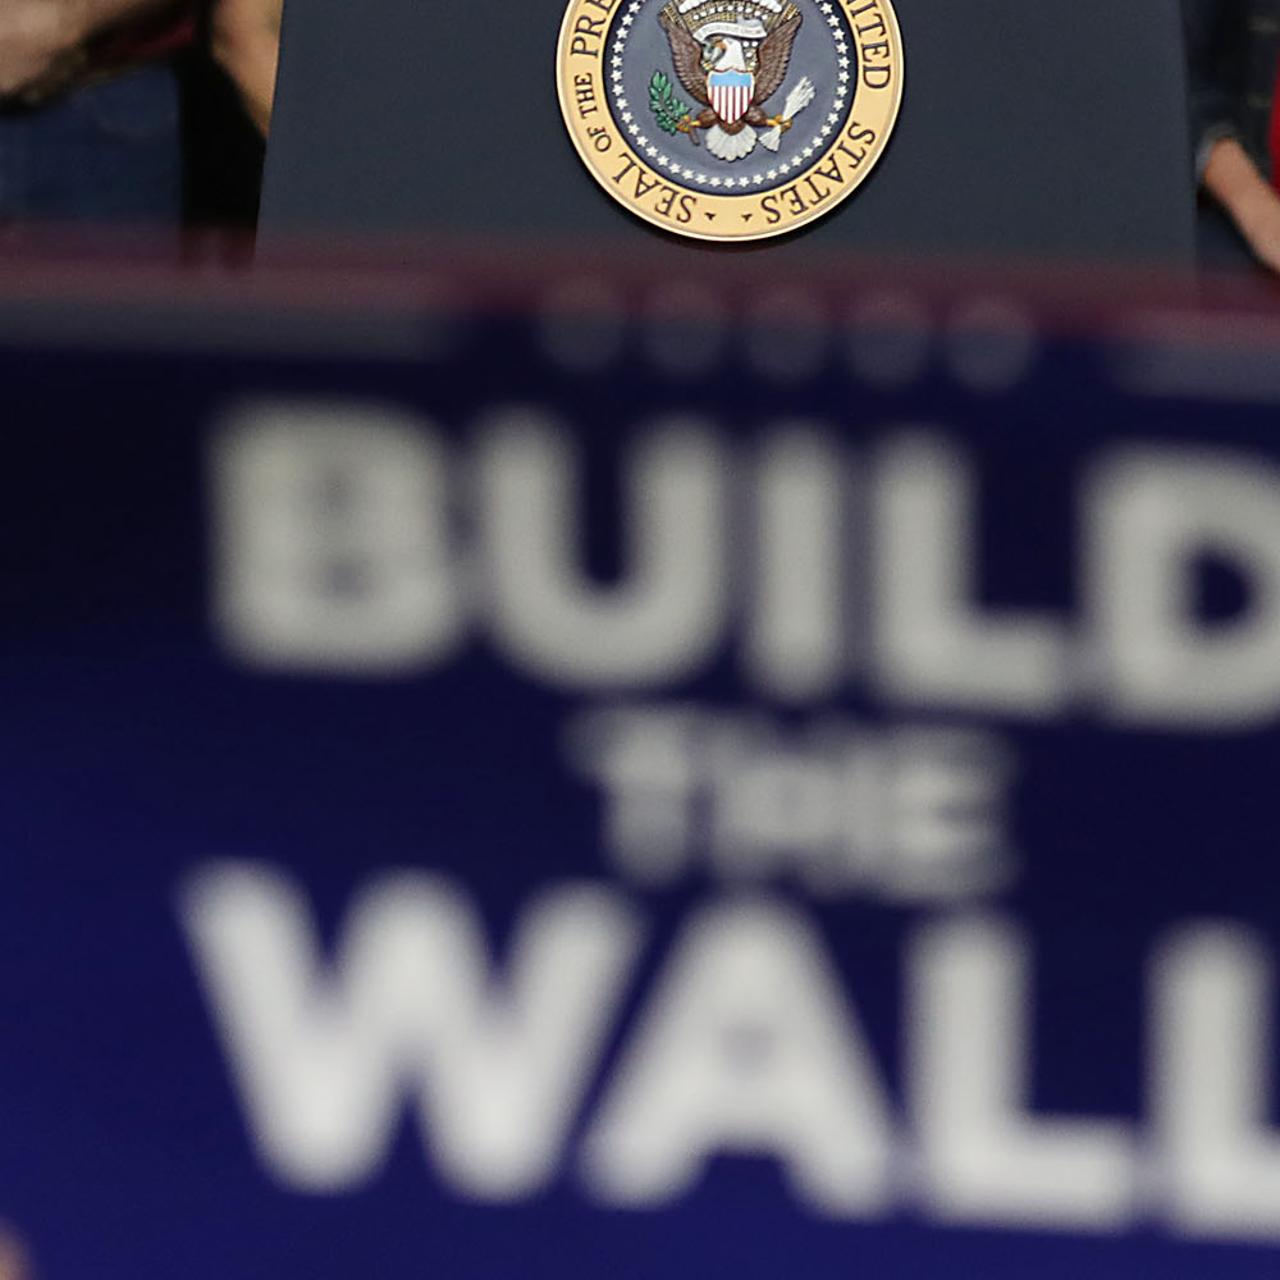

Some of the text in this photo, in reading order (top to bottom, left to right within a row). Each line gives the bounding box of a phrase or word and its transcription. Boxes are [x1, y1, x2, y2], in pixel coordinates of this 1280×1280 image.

[574, 71, 598, 119] THE
[586, 124, 612, 153] OF
[760, 121, 876, 224] STATES
[612, 152, 698, 224] SEAL
[568, 702, 1020, 902] THE
